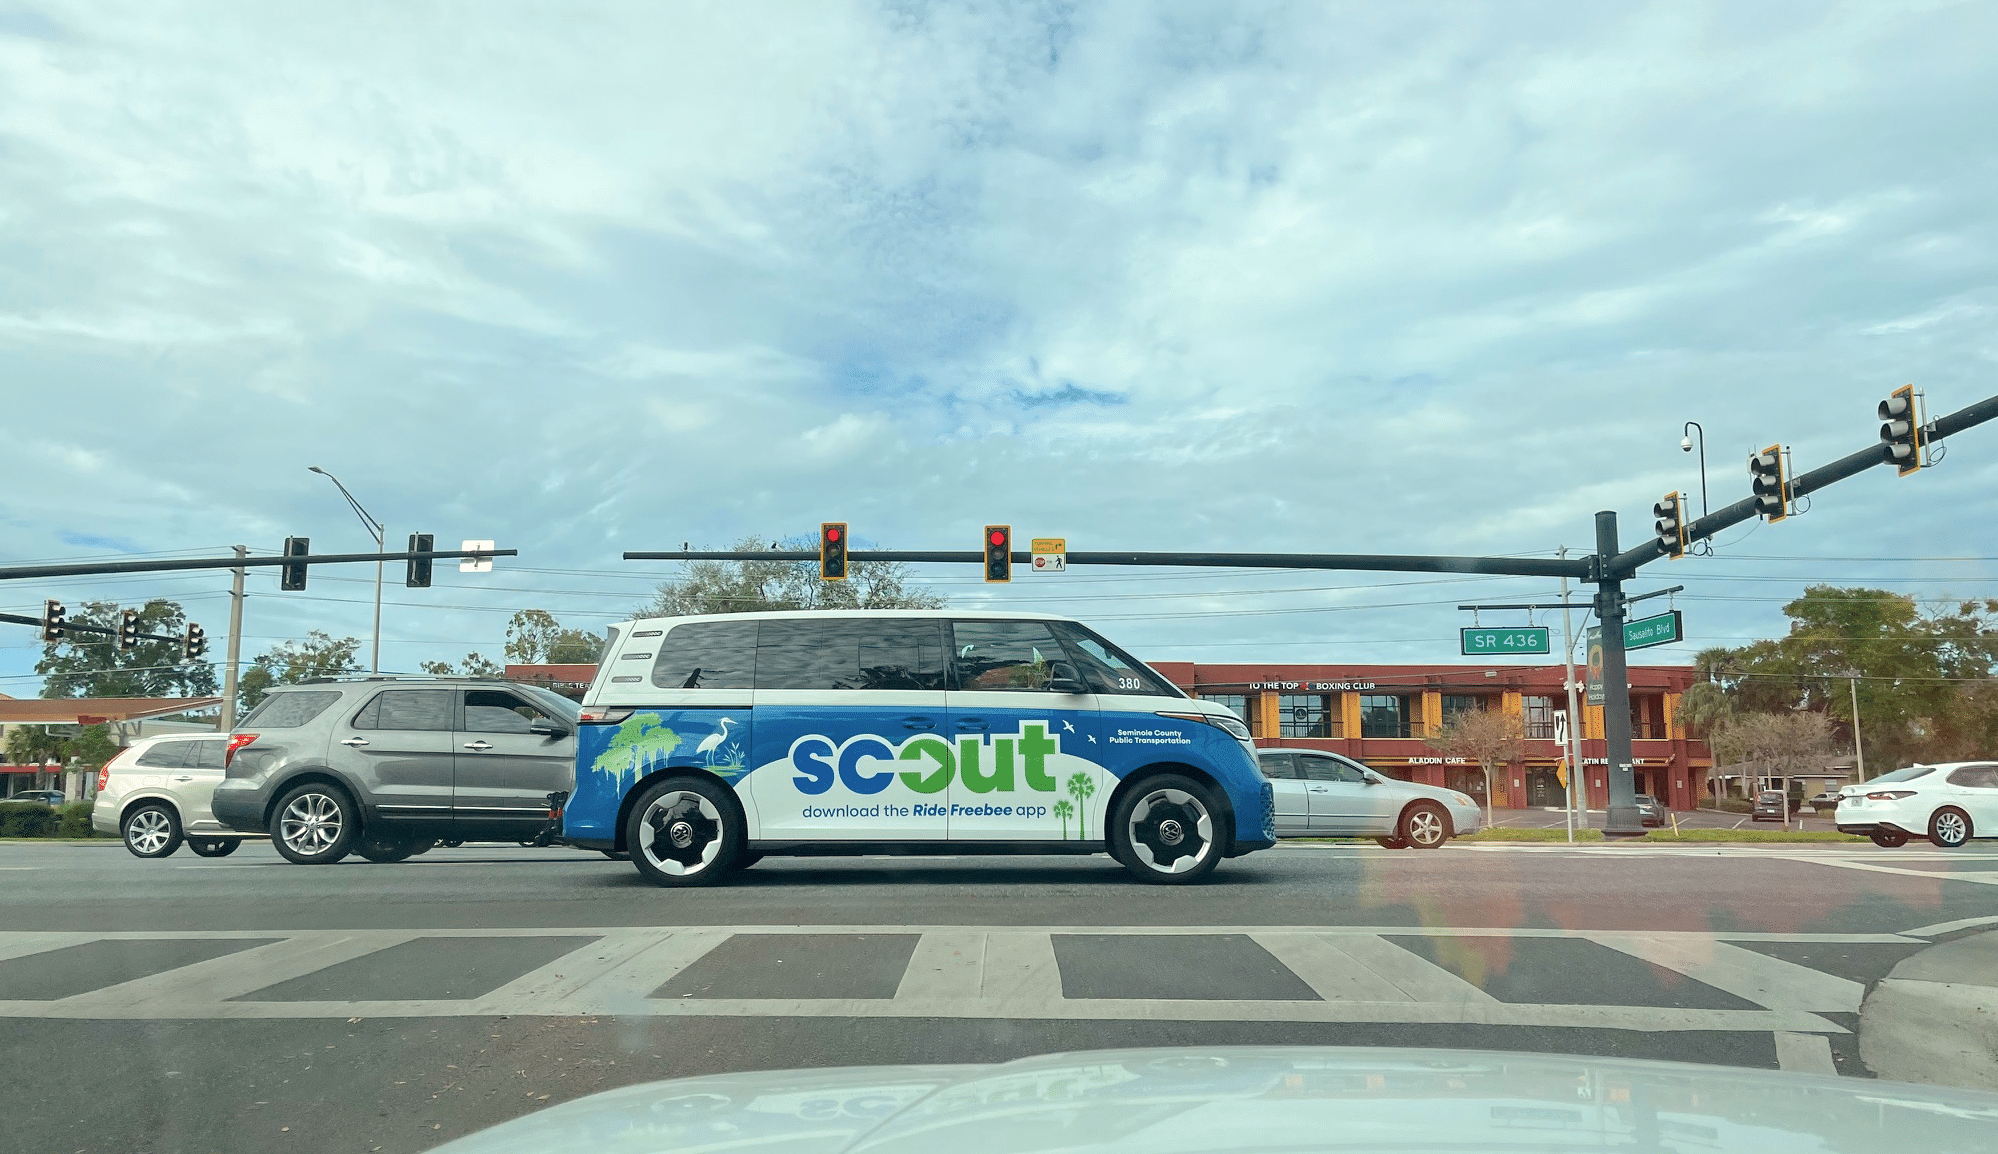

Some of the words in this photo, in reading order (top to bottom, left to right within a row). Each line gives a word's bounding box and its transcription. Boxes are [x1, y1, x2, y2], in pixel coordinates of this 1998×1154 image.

[1628, 626, 1654, 641] Sausalito
[1656, 622, 1670, 635] Blvd
[1475, 634, 1497, 648] SR
[1503, 634, 1538, 648] 436
[1118, 677, 1141, 690] 380
[1263, 682, 1280, 690] THE
[1281, 682, 1300, 690] TOP
[1316, 682, 1351, 691] BOXING
[1352, 682, 1376, 690] CLUB
[1117, 728, 1153, 737] Seminole
[1153, 729, 1182, 739] County
[1109, 736, 1133, 744] Public
[1134, 737, 1191, 745] Transportation
[792, 724, 1057, 796] scout
[1408, 757, 1443, 765] ALADDIN
[1445, 757, 1467, 765] CAFE
[802, 804, 880, 818] download
[883, 804, 909, 817] the
[913, 803, 947, 817] Ride
[950, 803, 1013, 817] Freebee
[1015, 805, 1047, 819] app
